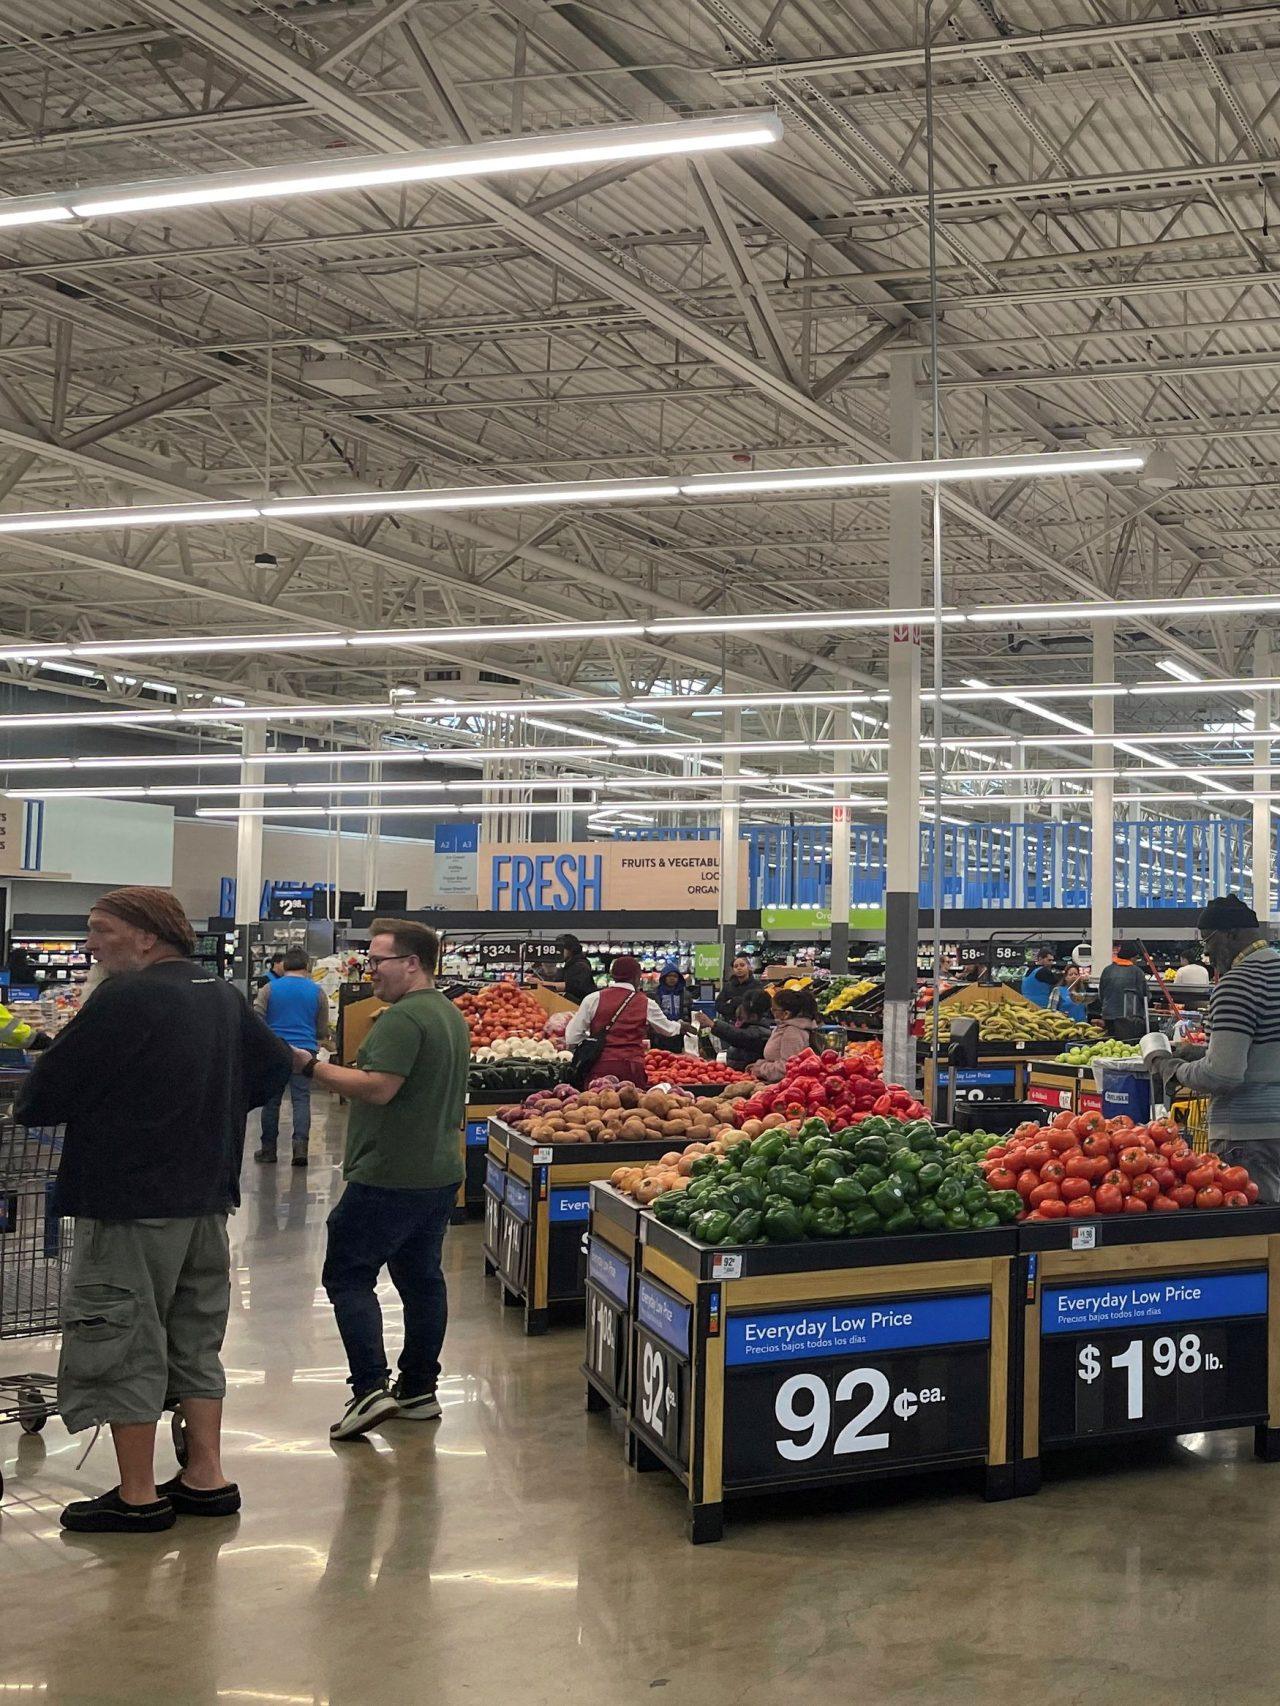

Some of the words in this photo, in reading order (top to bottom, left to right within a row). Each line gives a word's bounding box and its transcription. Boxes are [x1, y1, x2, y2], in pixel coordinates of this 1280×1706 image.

[621, 858, 656, 868] FRUITS
[658, 858, 666, 868] &
[668, 858, 719, 868] VEGETABL
[491, 854, 603, 912] FRESH
[701, 872, 720, 881] LOC
[482, 944, 511, 957] $324
[527, 944, 557, 957] $198
[1058, 1292, 1128, 1313] Everyday
[1132, 1290, 1161, 1305] Low
[1165, 1286, 1202, 1302] Price
[1058, 1315, 1087, 1325] Precios
[1088, 1313, 1109, 1324] bajos
[1110, 1310, 1132, 1319] todos
[1133, 1309, 1145, 1317] los
[745, 1319, 827, 1342] Everyday
[832, 1315, 866, 1333] Low
[871, 1311, 913, 1329] Price
[745, 1343, 780, 1355] Precios
[781, 1341, 805, 1353] bajos
[807, 1339, 833, 1349] todos
[834, 1337, 848, 1346] los
[1204, 1353, 1224, 1371] lb.
